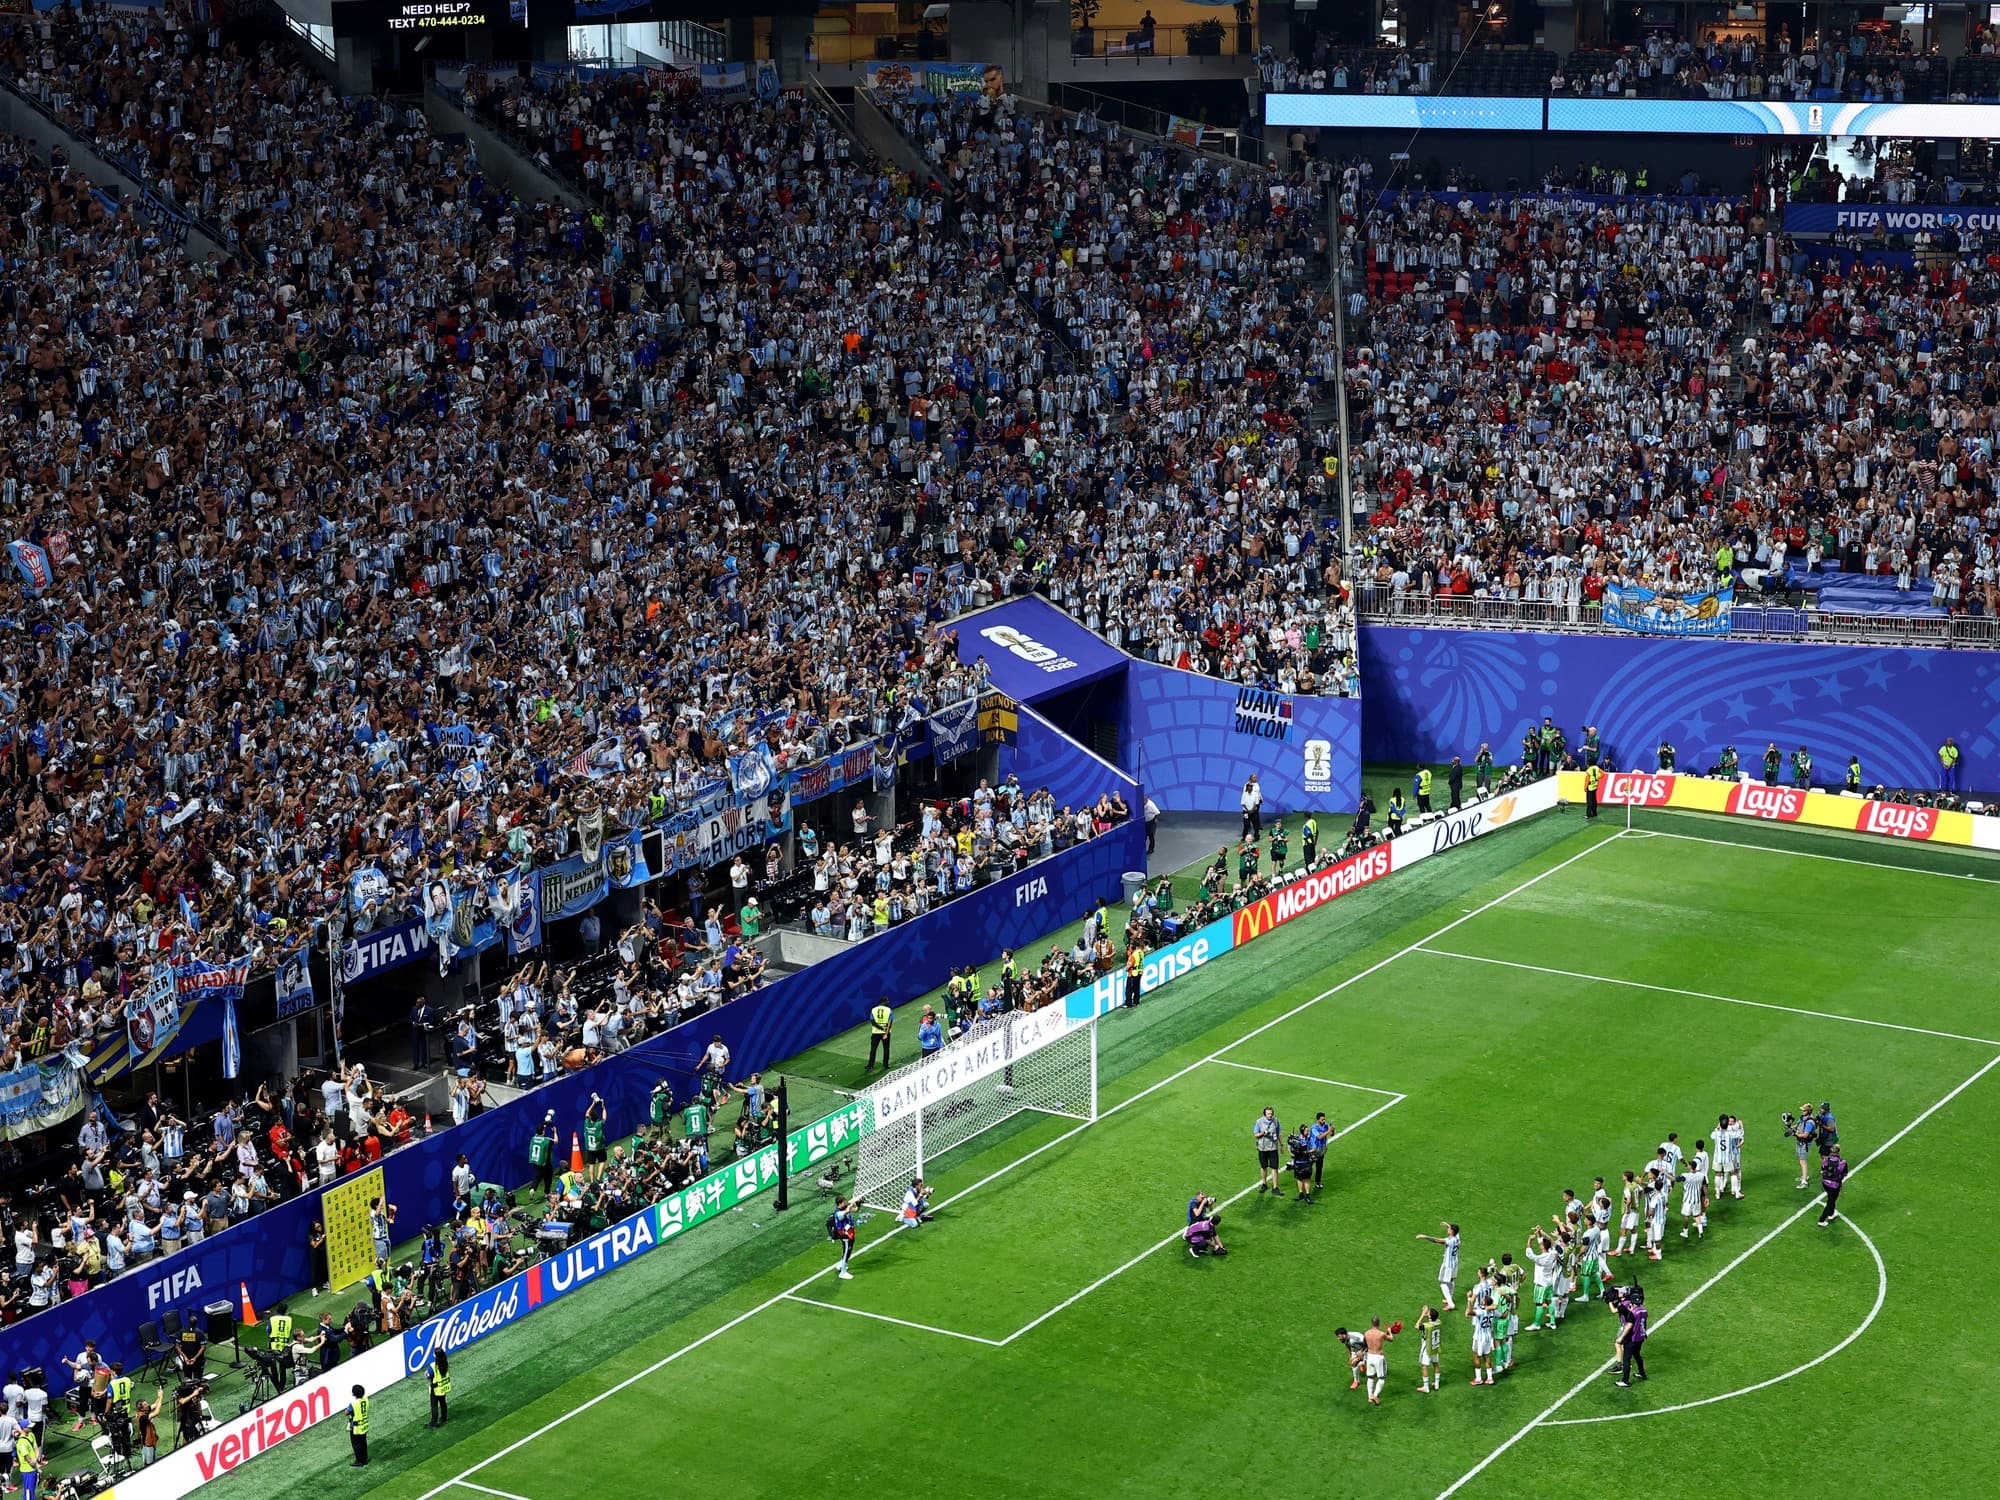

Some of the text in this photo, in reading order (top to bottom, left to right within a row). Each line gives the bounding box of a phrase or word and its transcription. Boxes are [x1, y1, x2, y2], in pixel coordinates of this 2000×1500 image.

[388, 15, 485, 28] TEXT 470-444-0234
[402, 3, 471, 15] NEED HELP?
[1734, 135, 1753, 145] 105
[1837, 211, 1880, 228] FIFA
[1967, 214, 2000, 232] CU
[1236, 688, 1279, 714] JUAN
[1236, 713, 1288, 740] RINCÓN
[1602, 773, 1666, 805] Lay's
[1736, 784, 1797, 818] Lay's
[1433, 812, 1482, 853] Dove
[1867, 801, 1929, 838] Lay's
[701, 820, 767, 870] ZAMORA
[566, 876, 601, 902] NEVAD
[1016, 876, 1048, 907] FIFA
[1276, 846, 1388, 922] McDonald's
[357, 933, 407, 977] FIFA
[1093, 937, 1209, 1019] Hiense
[881, 1020, 1042, 1117] BANK OF AMEICA
[685, 1177, 726, 1224] 蒙牛
[551, 1216, 654, 1292] ULTRA
[148, 1264, 202, 1311] FIFA
[408, 1283, 519, 1372] Michelob
[195, 1386, 331, 1481] verizon
